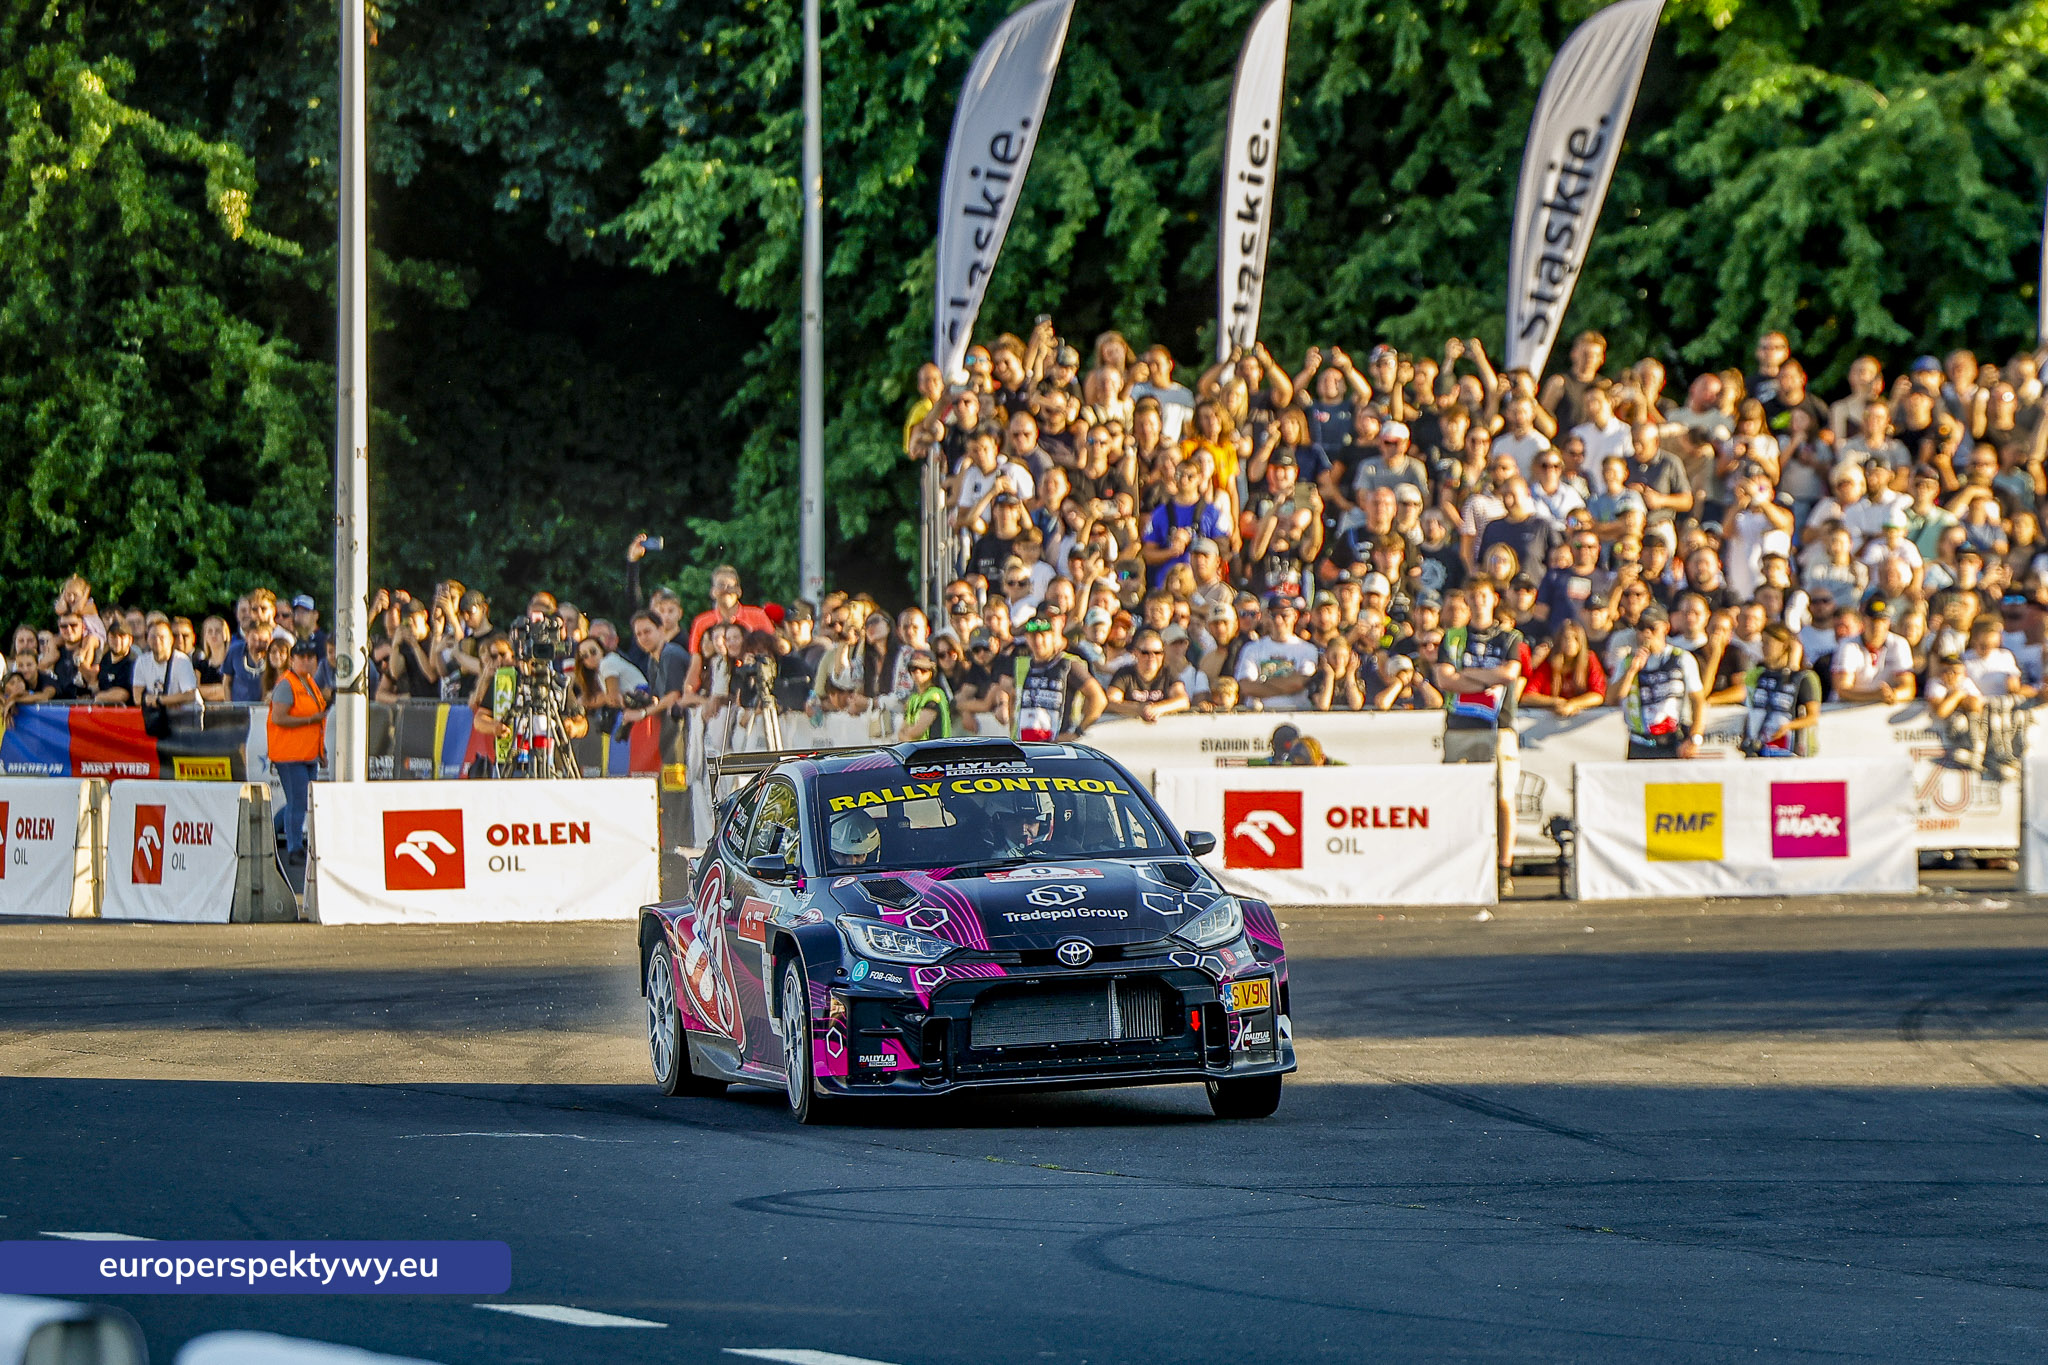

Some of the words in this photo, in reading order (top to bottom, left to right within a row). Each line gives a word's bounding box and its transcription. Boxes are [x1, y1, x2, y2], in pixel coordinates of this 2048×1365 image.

[1200, 737, 1250, 752] STADION
[7, 762, 64, 774] MICHELIN
[81, 762, 113, 774] MRF
[115, 762, 150, 776] TYRES
[909, 761, 1027, 775] RALLYLAB
[947, 767, 1033, 776] TECHNOLOGY
[828, 782, 943, 812] RALLY
[950, 777, 1130, 795] CONTROL
[1326, 806, 1430, 830] ORLEN
[1775, 804, 1806, 815] RMF
[15, 817, 55, 841] ORLEN
[1655, 813, 1716, 833] RMF
[172, 821, 213, 846] ORLEN
[486, 821, 591, 847] ORLEN
[1327, 836, 1364, 855] OIL
[13, 848, 28, 866] OIL
[171, 852, 186, 871] OIL
[488, 855, 526, 872] OIL
[1002, 907, 1076, 923] Tradepol
[1078, 907, 1129, 921] Group
[1232, 985, 1240, 1007] S
[1242, 982, 1269, 1006] V9N
[858, 1054, 895, 1063] RALLYLAB
